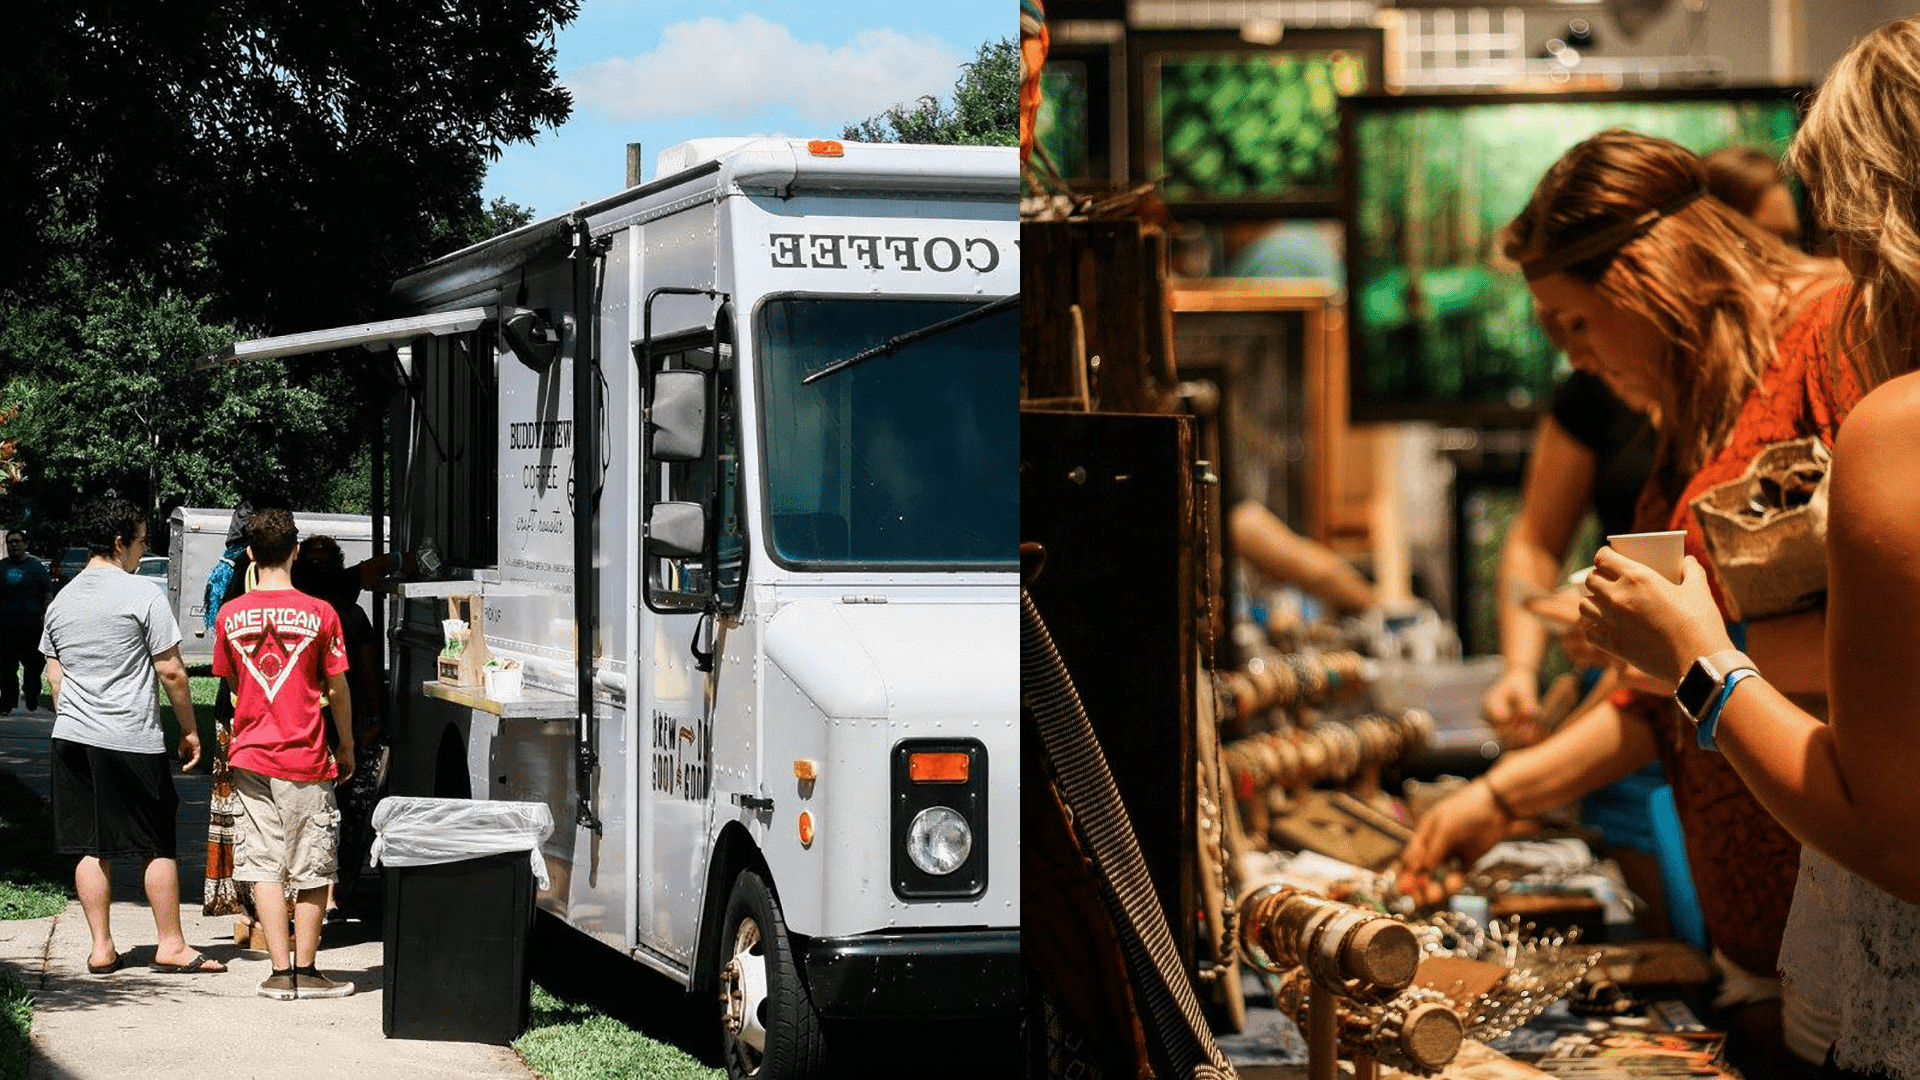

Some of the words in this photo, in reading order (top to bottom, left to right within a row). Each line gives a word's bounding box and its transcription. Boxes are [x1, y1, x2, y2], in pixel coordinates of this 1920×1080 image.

[523, 466, 558, 489] COFFEE
[224, 608, 322, 633] AMERICAN
[653, 709, 677, 750] BREW
[652, 753, 674, 795] GOOD
